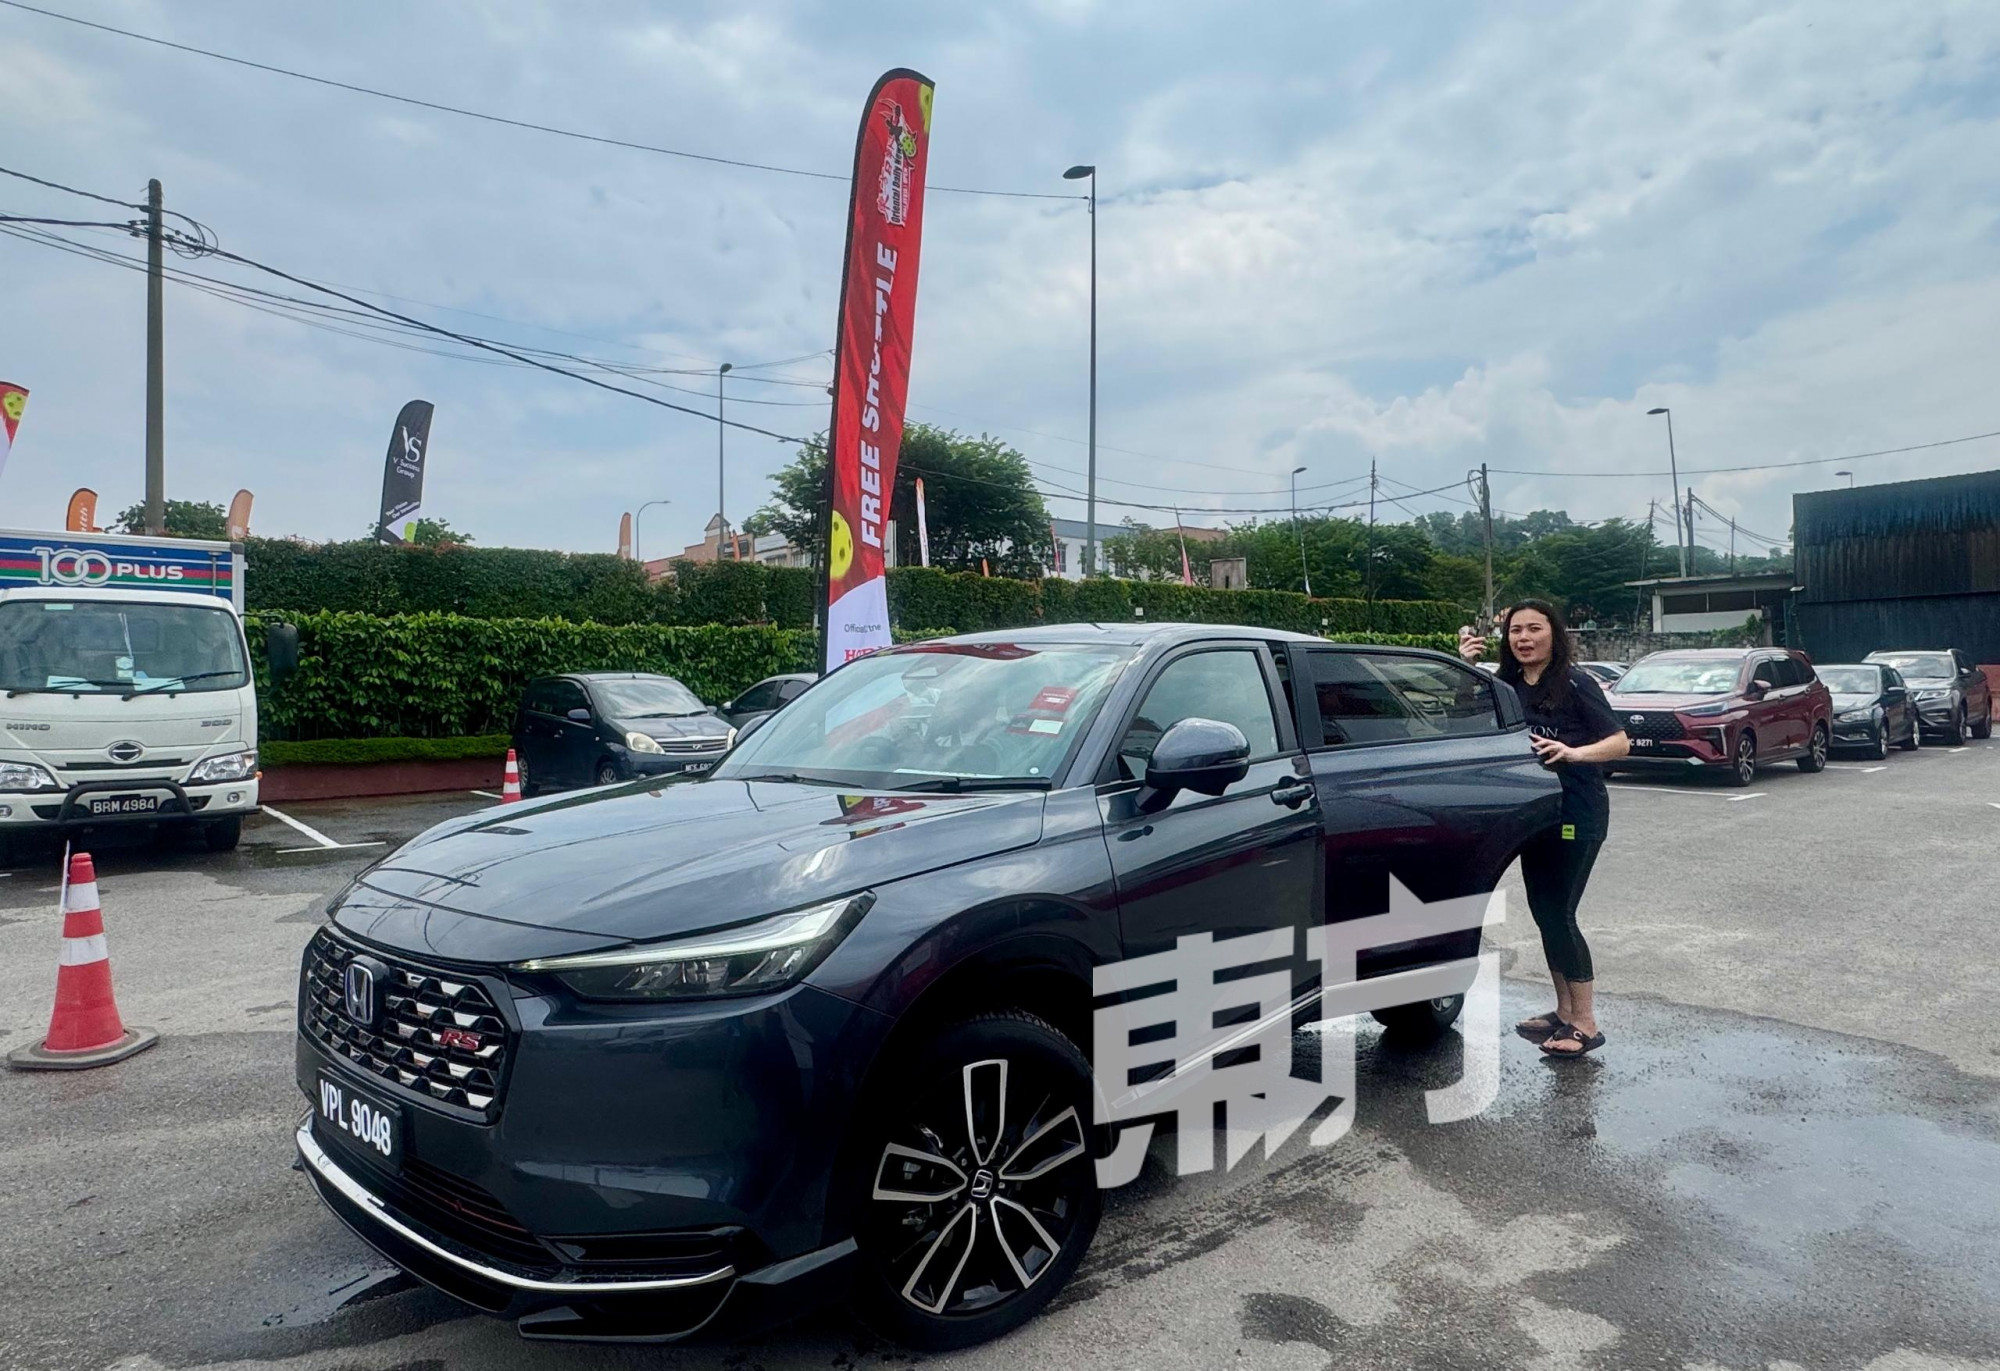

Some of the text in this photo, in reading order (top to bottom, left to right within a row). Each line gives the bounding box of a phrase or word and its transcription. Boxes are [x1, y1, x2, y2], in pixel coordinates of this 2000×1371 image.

[893, 165, 903, 188] Daily
[891, 187, 901, 223] Oriental
[396, 466, 415, 479] Group
[861, 440, 880, 548] FREE
[36, 550, 183, 584] 100 PLUS
[6, 723, 50, 731] HINO
[200, 718, 232, 727] 300
[93, 797, 155, 814] BRM 4984
[440, 1028, 483, 1050] RS
[320, 1079, 392, 1156] VPL 9048
